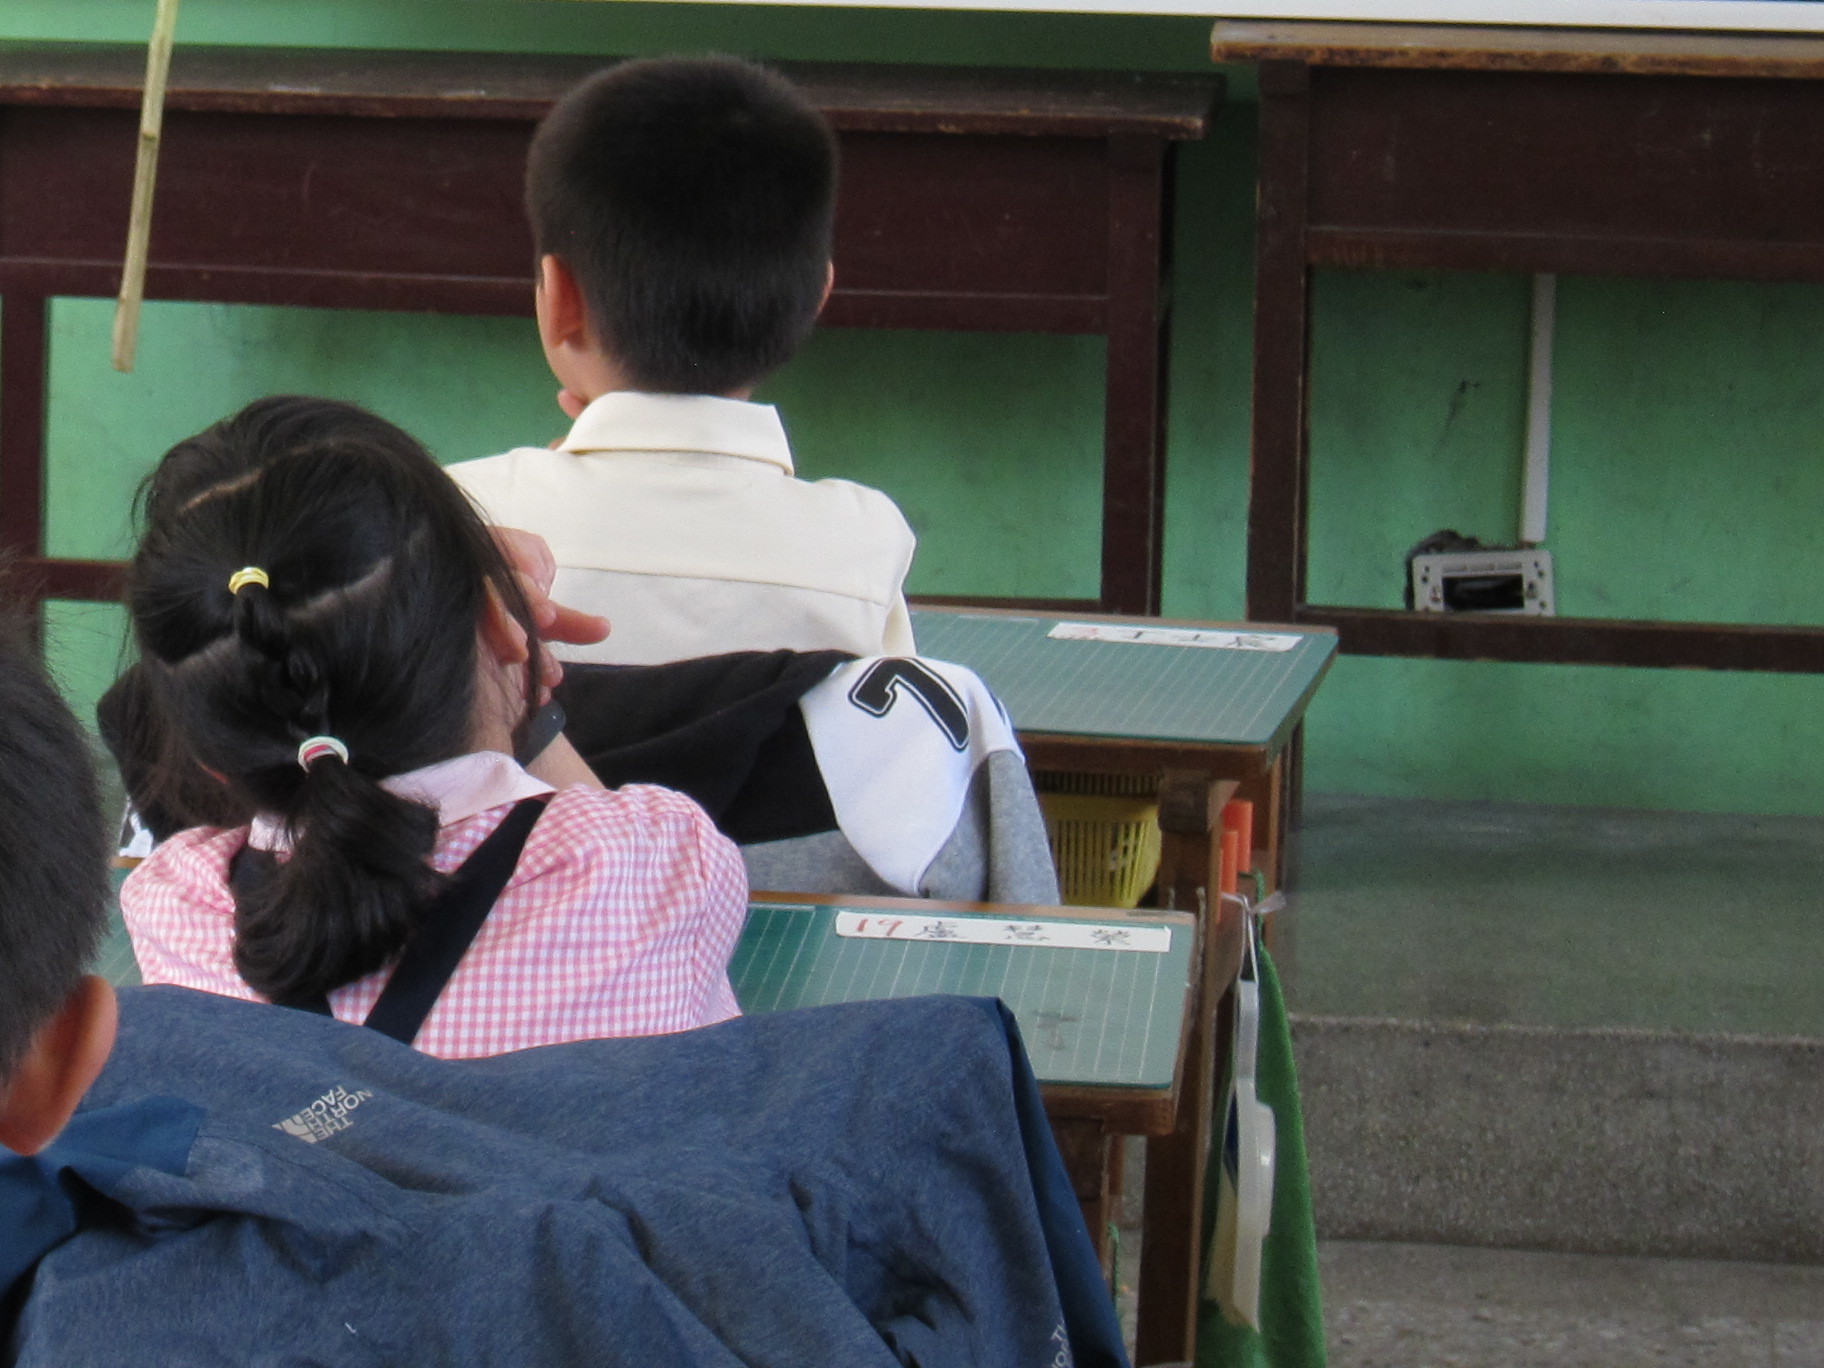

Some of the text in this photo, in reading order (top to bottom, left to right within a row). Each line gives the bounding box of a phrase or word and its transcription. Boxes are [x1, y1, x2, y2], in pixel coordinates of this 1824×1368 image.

[847, 656, 971, 753] 7
[301, 1085, 347, 1124] FACE
[307, 1089, 374, 1131] NORTH
[317, 1116, 355, 1141] THE
